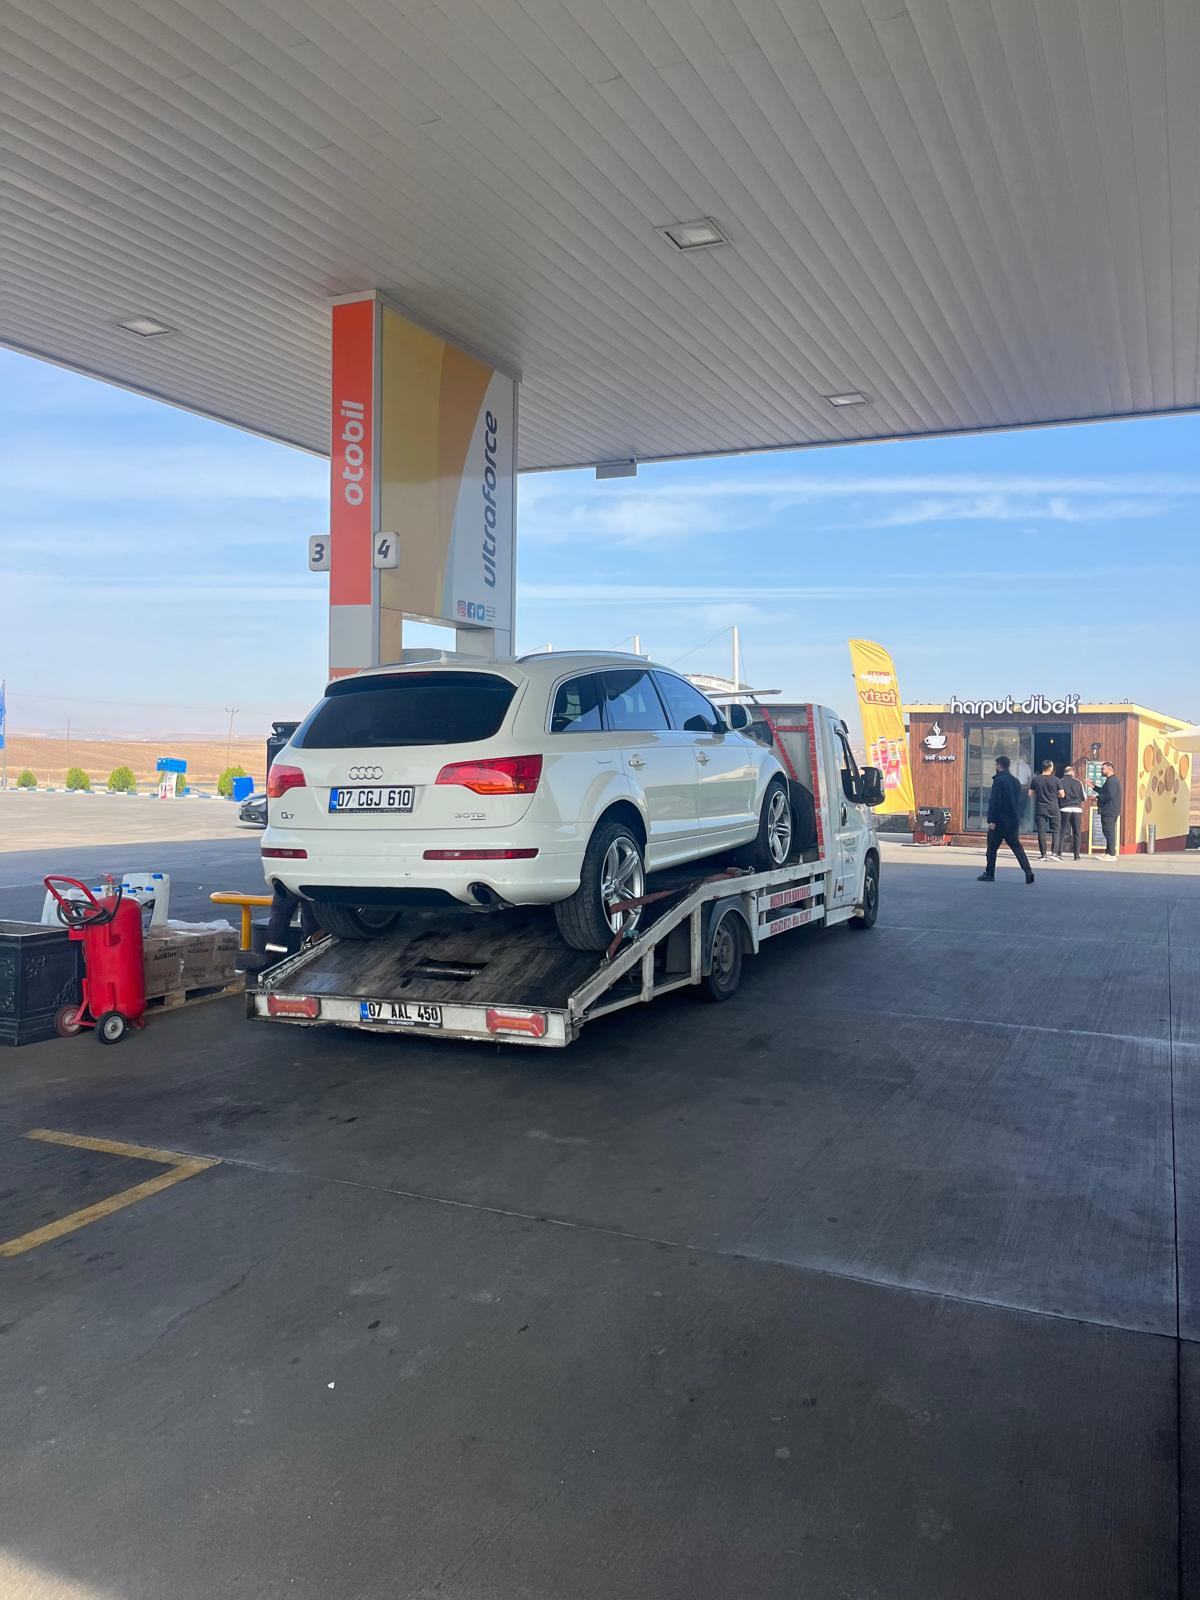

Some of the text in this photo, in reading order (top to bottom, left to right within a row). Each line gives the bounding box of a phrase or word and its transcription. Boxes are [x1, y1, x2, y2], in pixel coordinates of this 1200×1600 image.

[341, 399, 365, 506] otobil
[482, 410, 498, 588] ultraforce
[312, 543, 325, 562] 3
[378, 539, 391, 559] 4
[950, 694, 1078, 719] harput dibek
[337, 790, 411, 807] 07 CGJ 610
[281, 811, 295, 820] Q7
[368, 1001, 439, 1022] 07 AAL 450
